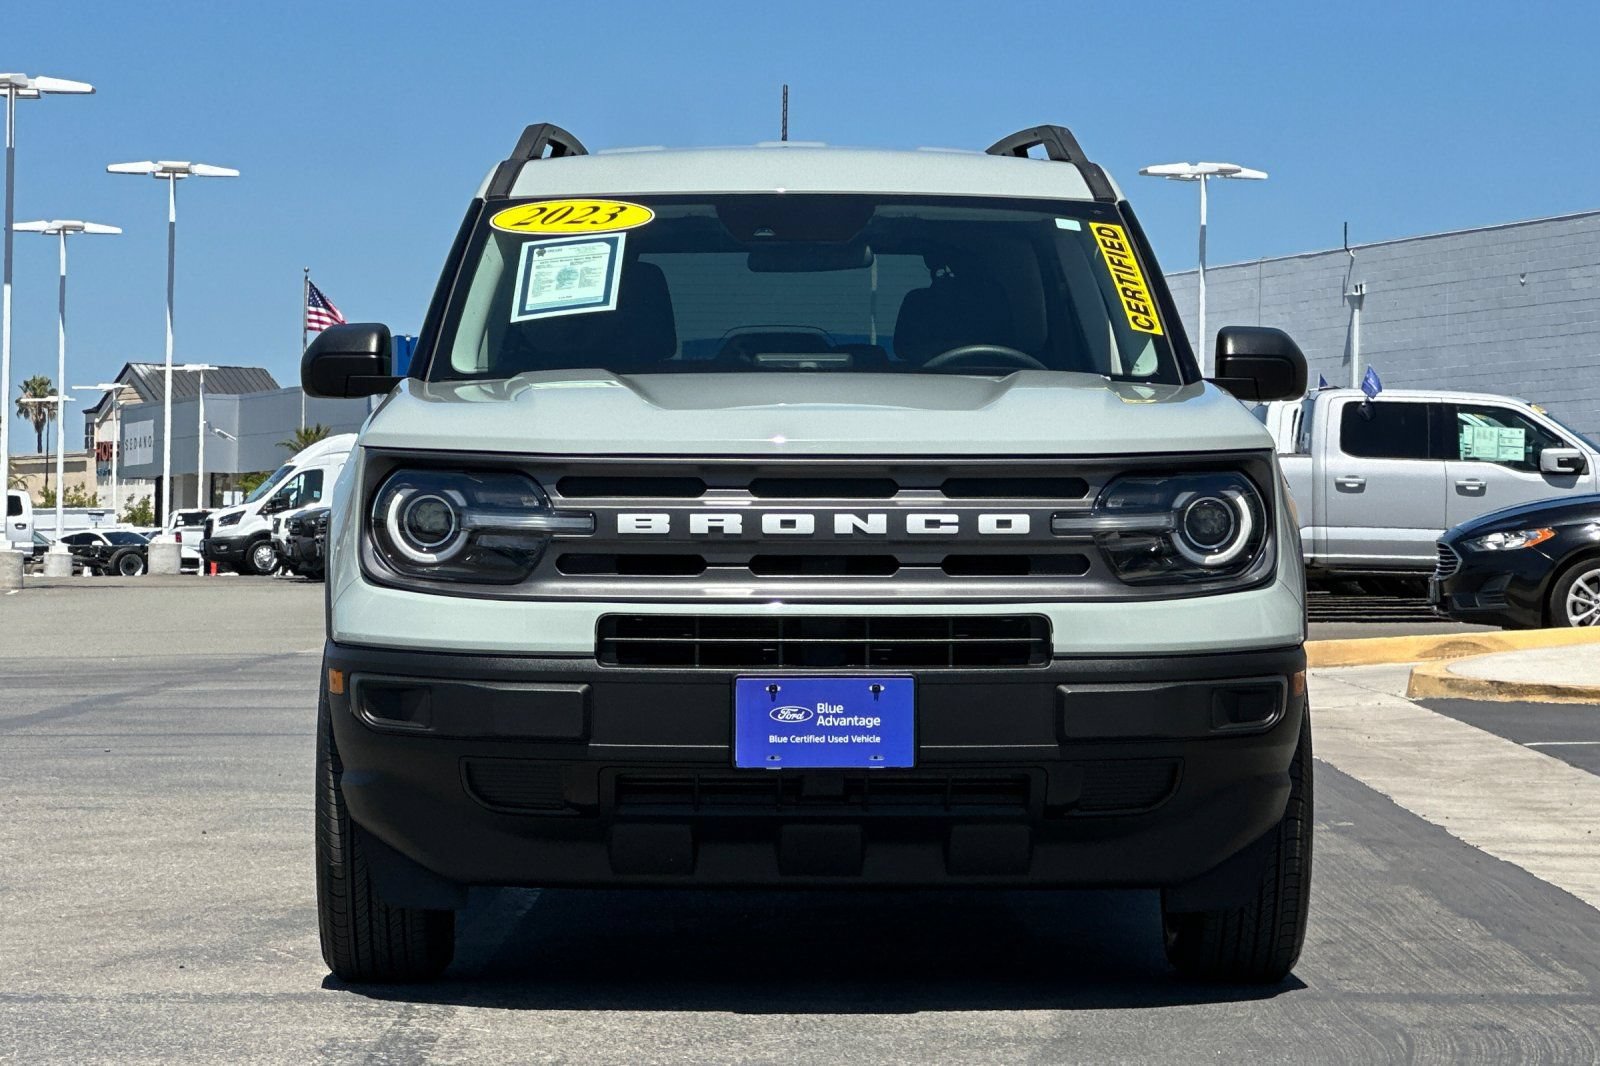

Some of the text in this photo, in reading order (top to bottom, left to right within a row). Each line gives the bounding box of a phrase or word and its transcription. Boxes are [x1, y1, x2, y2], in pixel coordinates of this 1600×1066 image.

[511, 205, 628, 227] 2023
[1095, 226, 1155, 331] CERTIFIED
[616, 513, 1030, 534] BRONCO
[777, 708, 805, 720] Ford
[816, 702, 844, 714] Blue
[816, 715, 881, 728] Advantage
[769, 735, 881, 744] Blue Certified Used Vehicle
